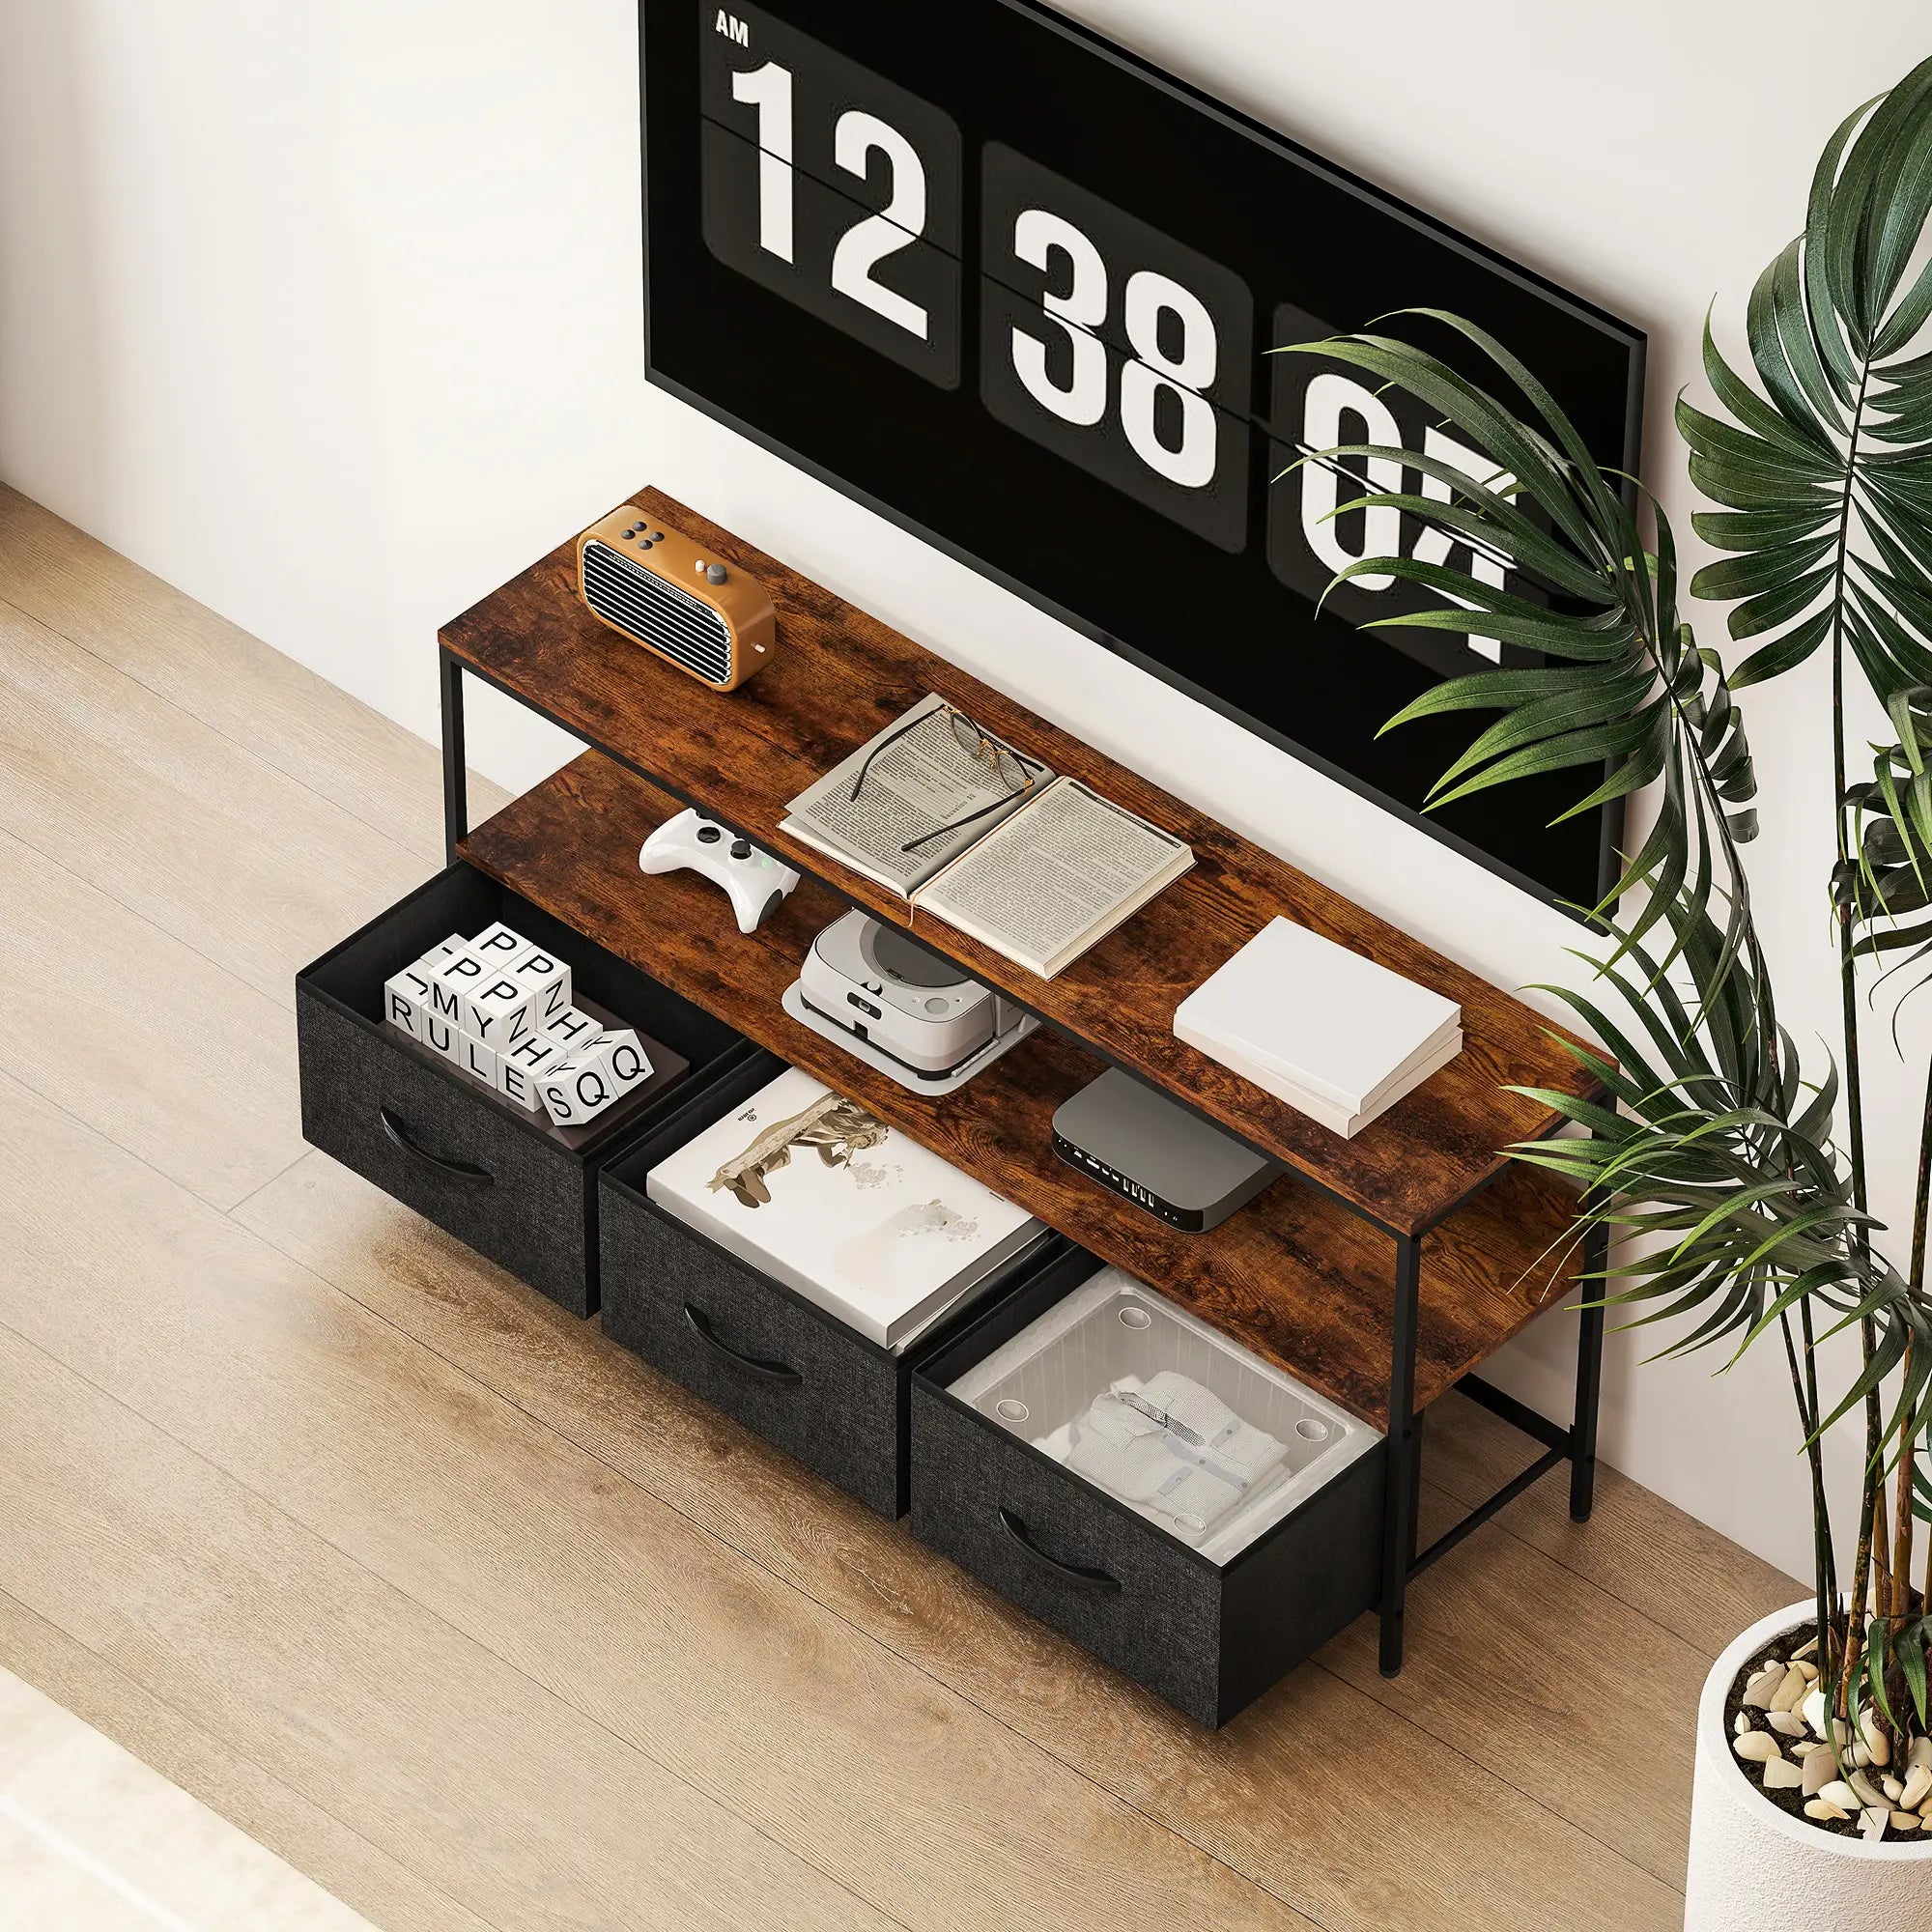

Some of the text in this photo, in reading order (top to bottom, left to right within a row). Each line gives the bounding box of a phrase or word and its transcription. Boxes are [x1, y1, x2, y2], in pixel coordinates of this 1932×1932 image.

[715, 9, 750, 48] AM
[731, 61, 929, 341] 12
[1011, 209, 1218, 490] 38
